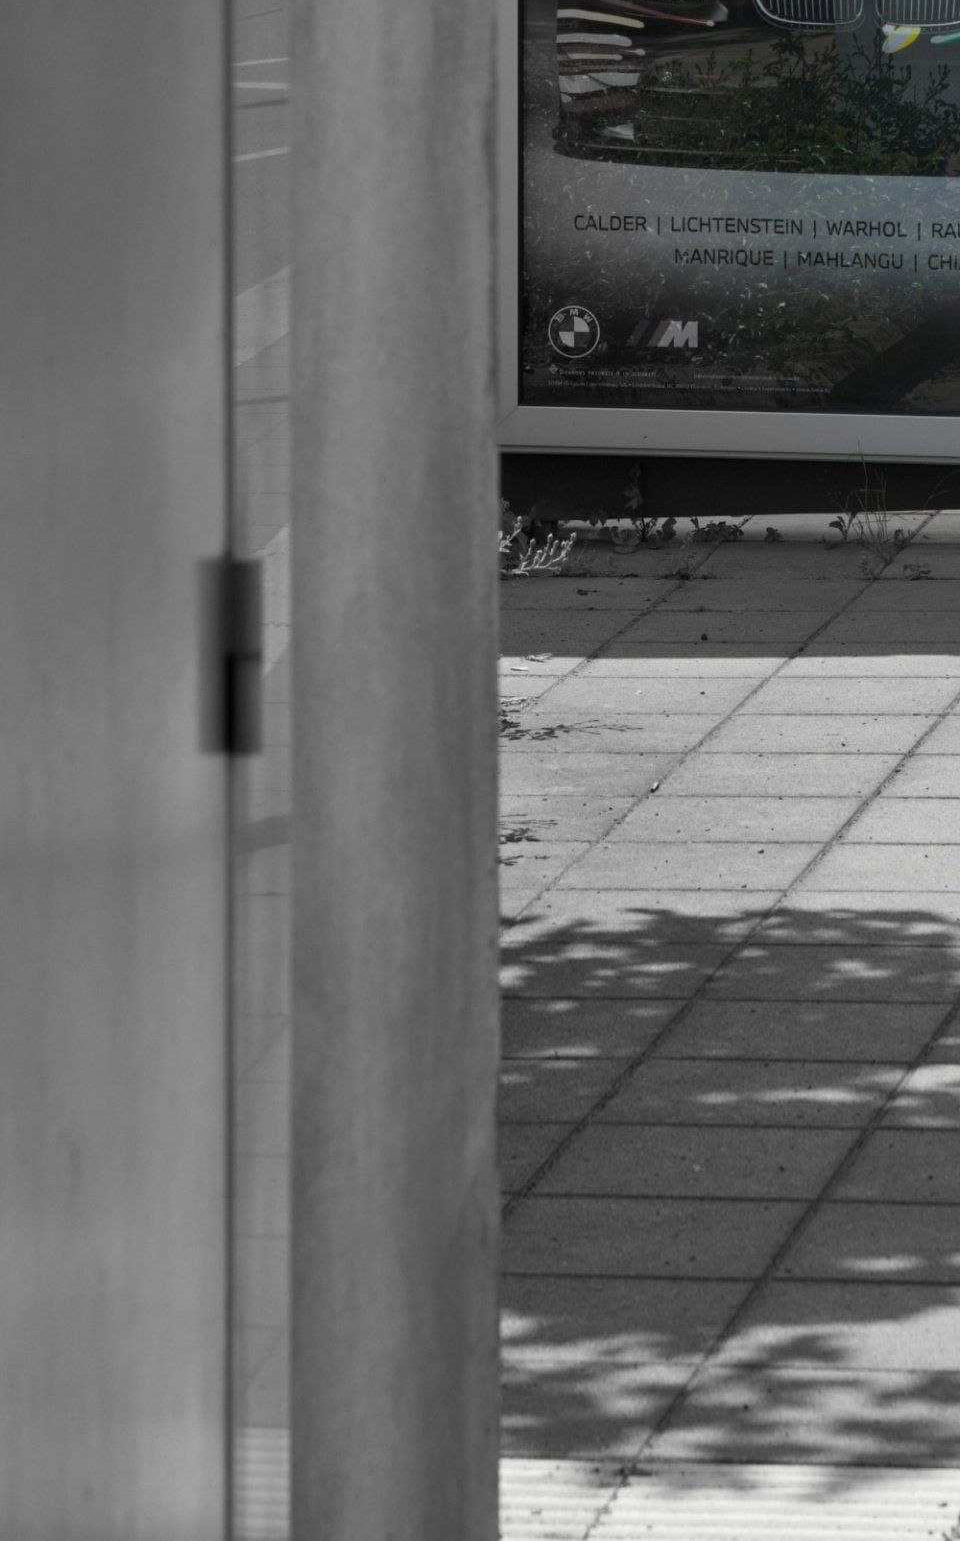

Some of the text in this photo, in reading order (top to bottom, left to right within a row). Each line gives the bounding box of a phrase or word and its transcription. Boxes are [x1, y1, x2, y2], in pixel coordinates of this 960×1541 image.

[573, 214, 648, 232] CALDER
[671, 216, 803, 235] LICHTENSTEIN
[826, 219, 908, 239] WARHOL
[674, 248, 774, 268] MANRIQUE
[797, 250, 904, 270] MAHLANGU
